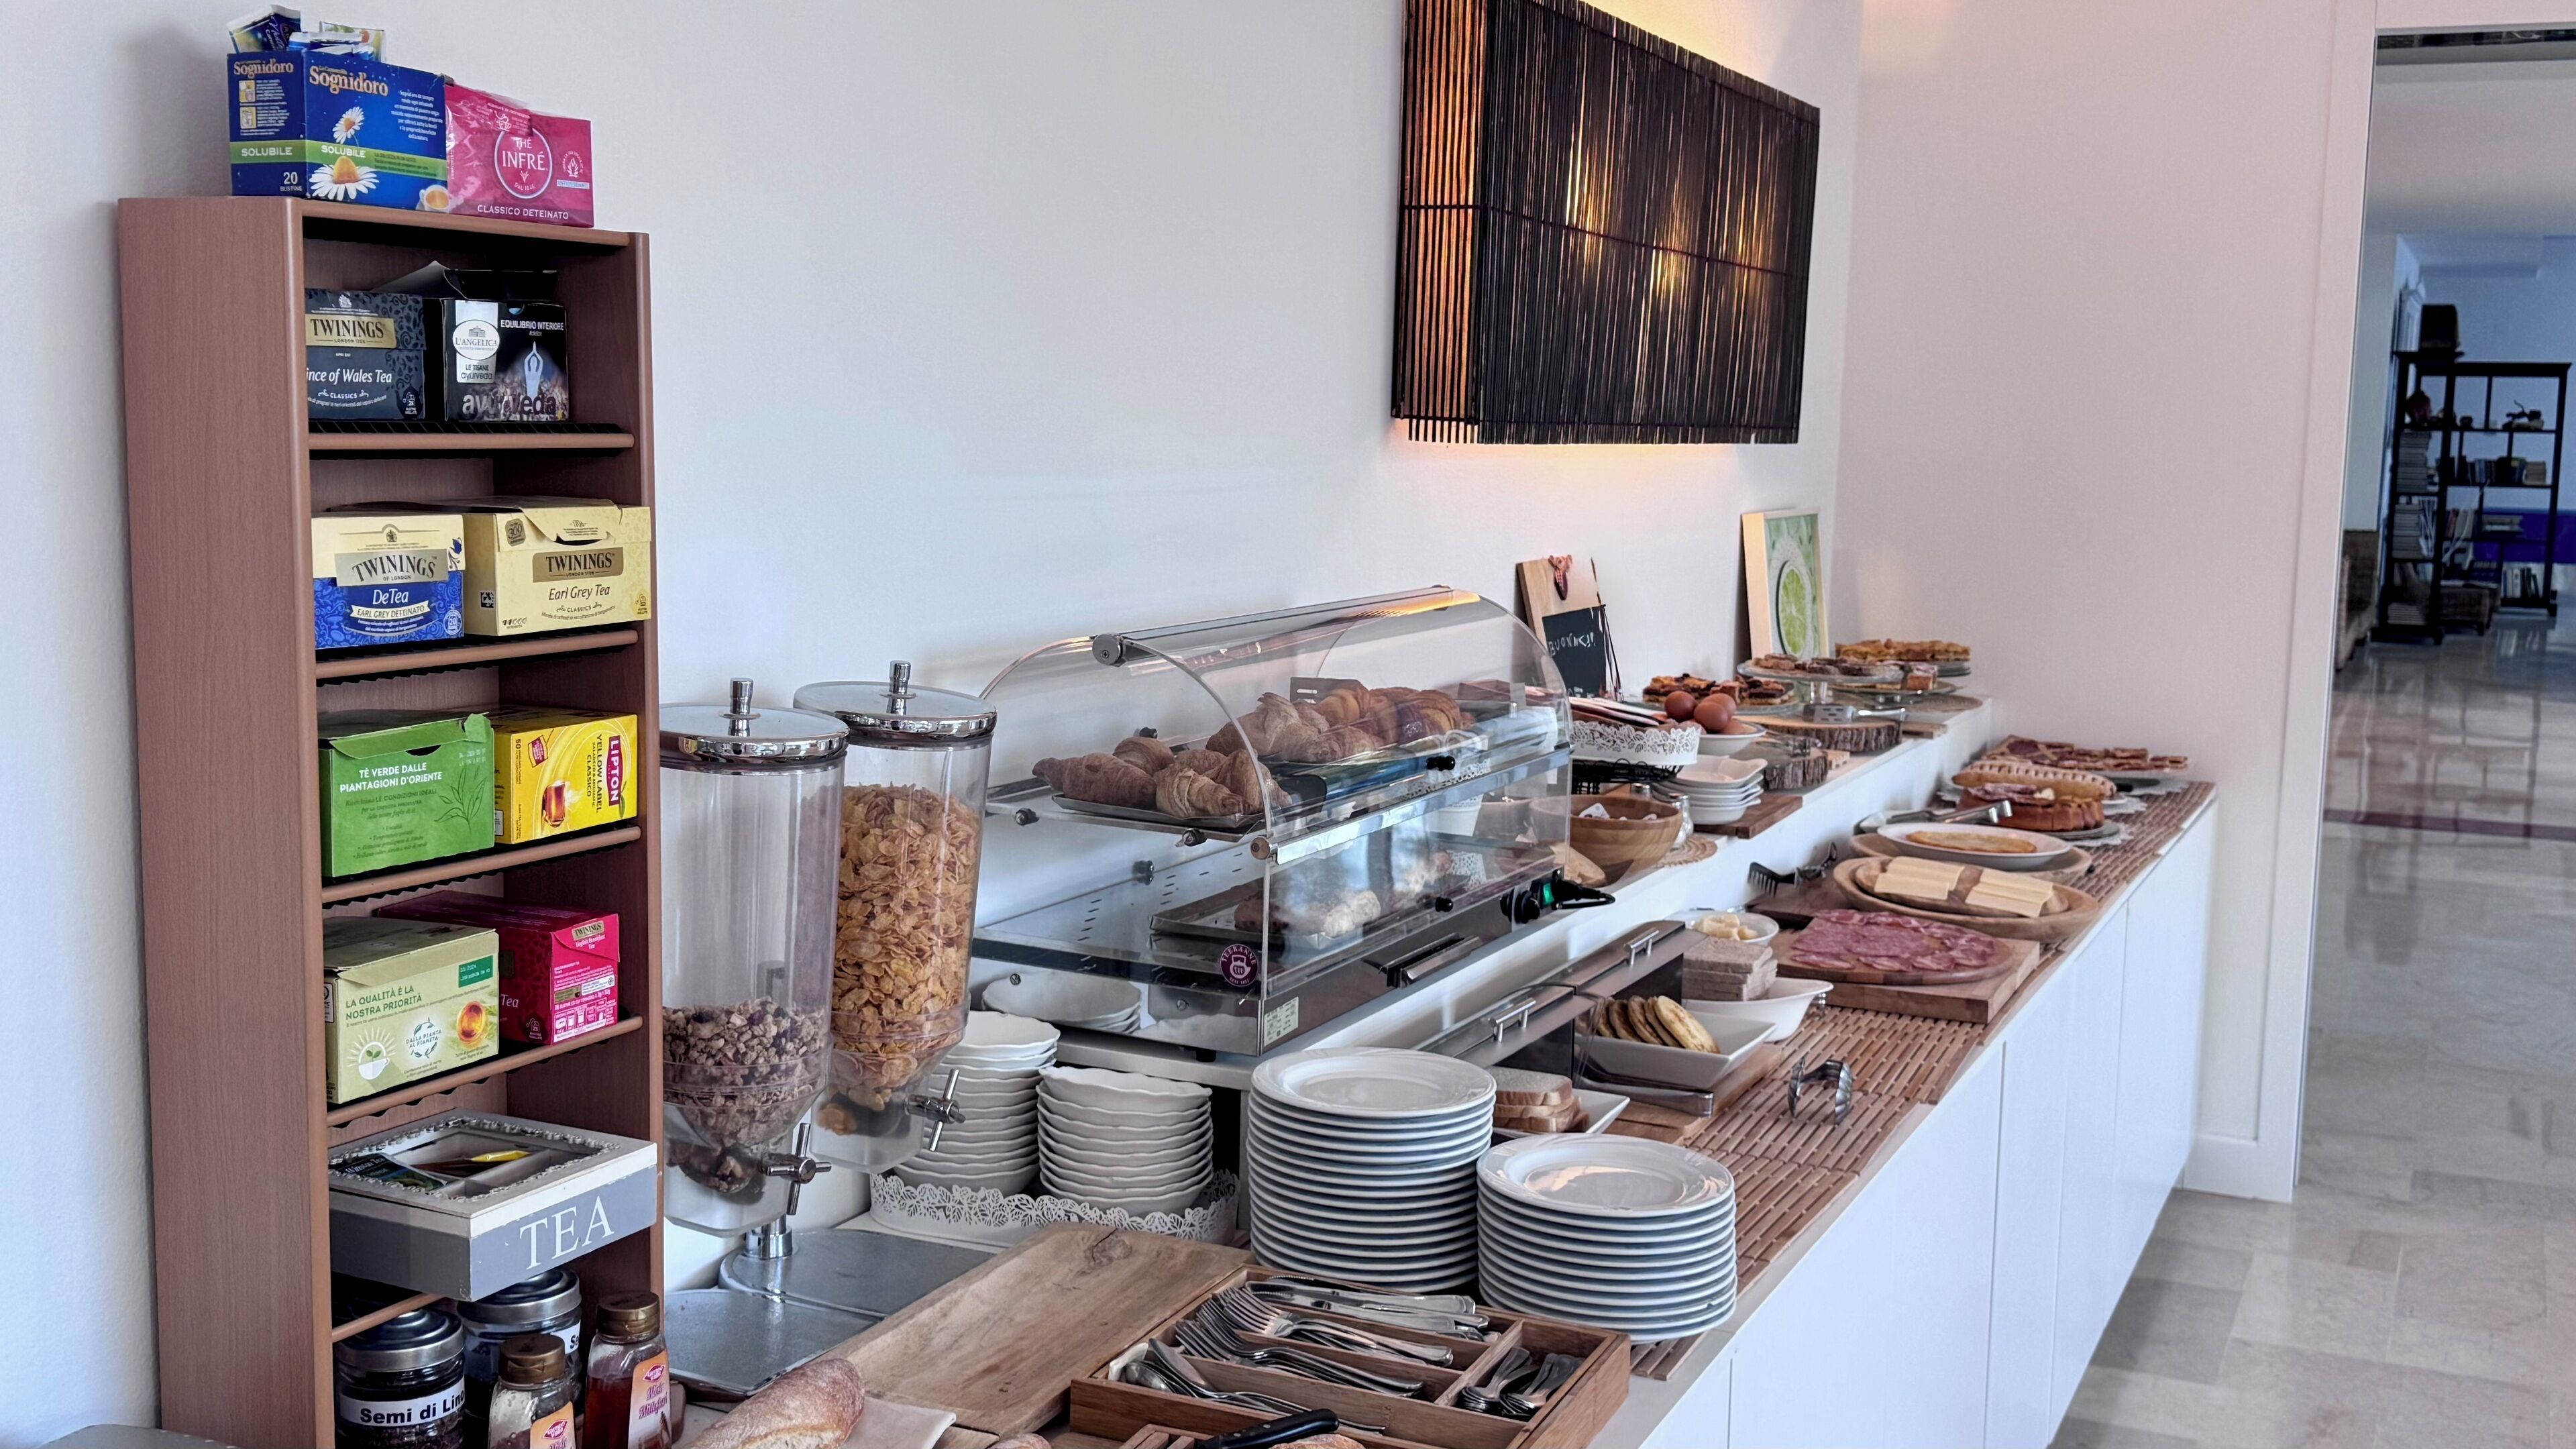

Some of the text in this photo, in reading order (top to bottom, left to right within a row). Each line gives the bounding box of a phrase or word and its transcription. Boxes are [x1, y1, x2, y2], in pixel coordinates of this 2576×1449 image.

[309, 65, 389, 97] Sognid'oro
[241, 147, 292, 157] SOLUBILE
[321, 144, 366, 158] SOLUBILE
[502, 150, 545, 170] INFRÉ
[283, 171, 298, 185] 20
[477, 205, 569, 219] CLASSICO DETEINATO
[310, 319, 384, 338] TWININGS
[500, 319, 565, 331] EQUILIBRIO INTERIORE
[455, 337, 497, 346] L'ANGELICA
[307, 368, 392, 385] ince of Wales Tea
[460, 372, 492, 380] ayurveda
[508, 525, 523, 539] 300
[352, 554, 435, 582] TWININGS
[546, 552, 612, 572] TWININGS
[372, 588, 409, 604] DeTea
[549, 584, 610, 600] Earl Grey Tea
[357, 604, 425, 619] EARL GREY DETEINATO
[568, 605, 592, 613] CLASSICS
[515, 739, 521, 749] 50
[359, 762, 427, 779] TÈ VERDE DALLE
[610, 740, 620, 802] LIPTON
[340, 771, 443, 794] PIANTAGIONI D'ORIENTE
[574, 922, 602, 936] TWININGS
[1222, 946, 1256, 965] TEEKANNE
[345, 999, 357, 1008] LA
[359, 987, 396, 1005] QUALITÀ
[405, 985, 415, 994] LA
[500, 994, 519, 1008] Tea
[345, 1005, 381, 1020] NOSTRA
[383, 993, 422, 1012] PRIORITÀ
[406, 1035, 422, 1044] DALLA
[520, 1196, 614, 1270] TEA
[360, 1389, 464, 1424] Semi di Lino
